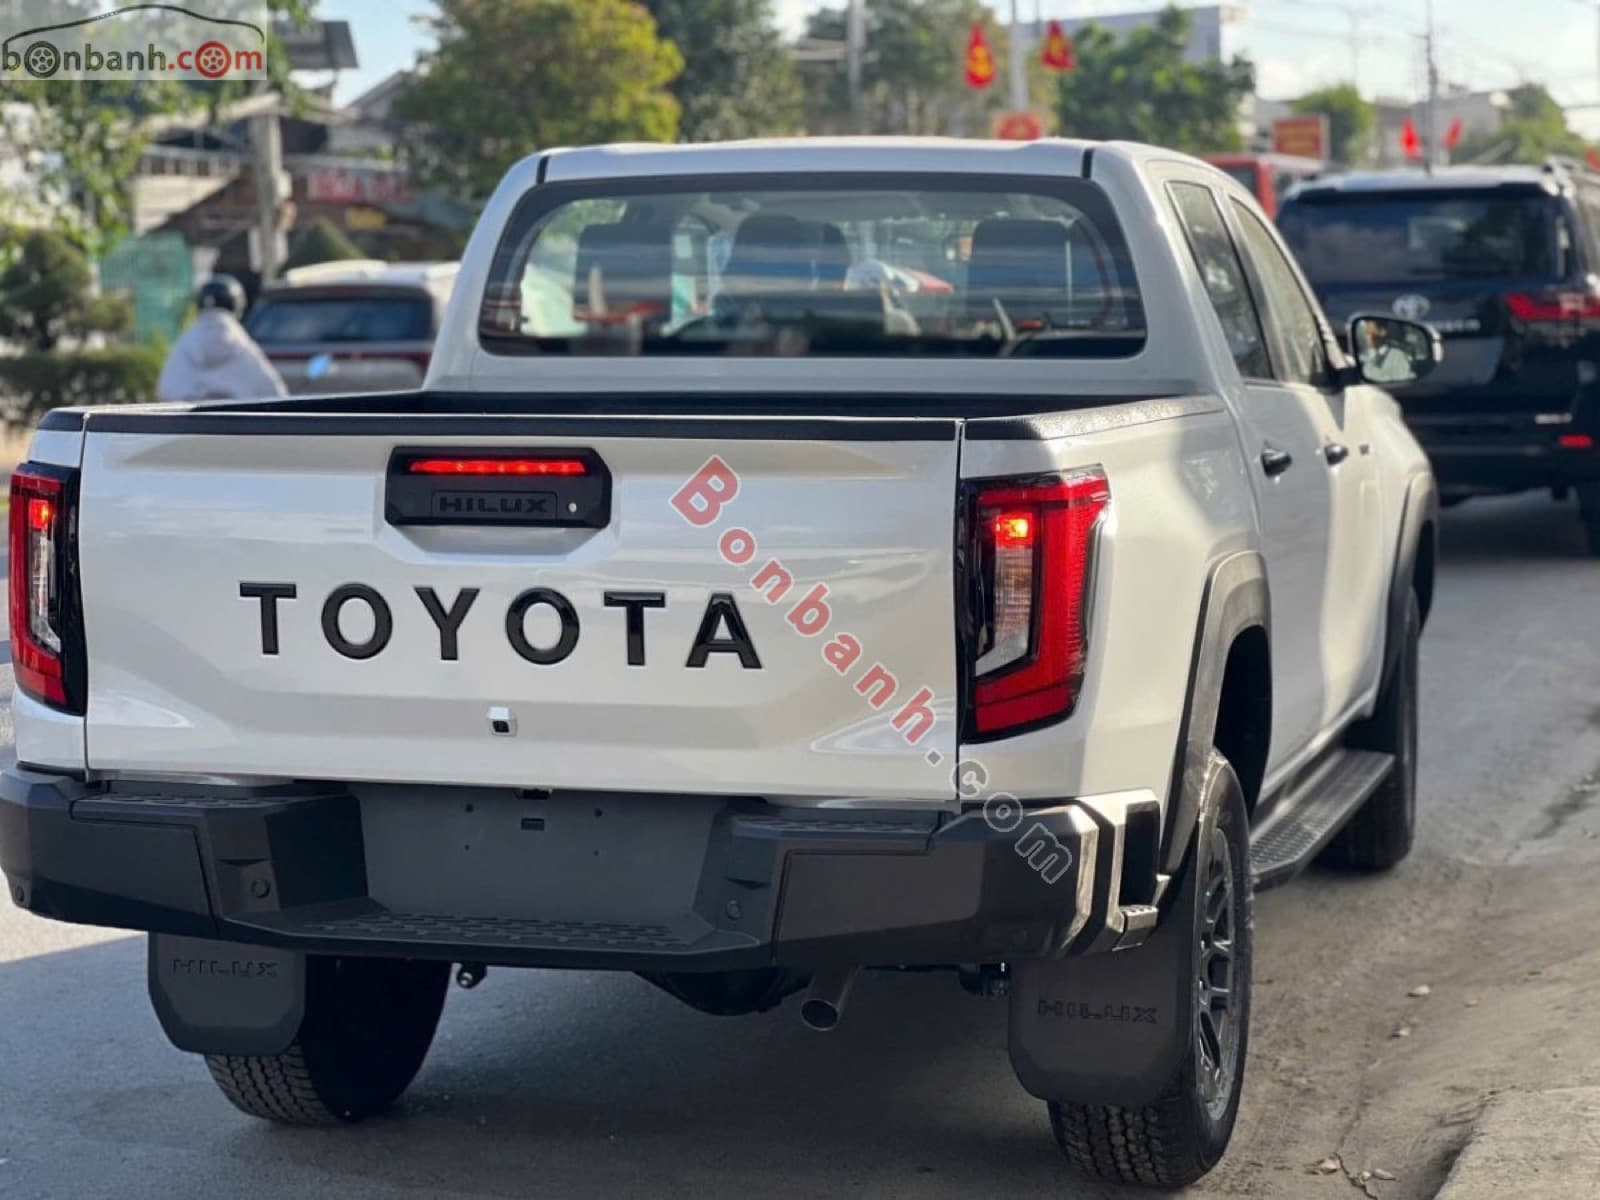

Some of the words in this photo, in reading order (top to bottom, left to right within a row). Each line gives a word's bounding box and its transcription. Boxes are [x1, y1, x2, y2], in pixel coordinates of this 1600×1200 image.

[439, 496, 548, 513] HILUX
[239, 582, 763, 669] TOYOTA
[172, 958, 279, 977] HILUX
[1036, 1000, 1159, 1025] HILUX
